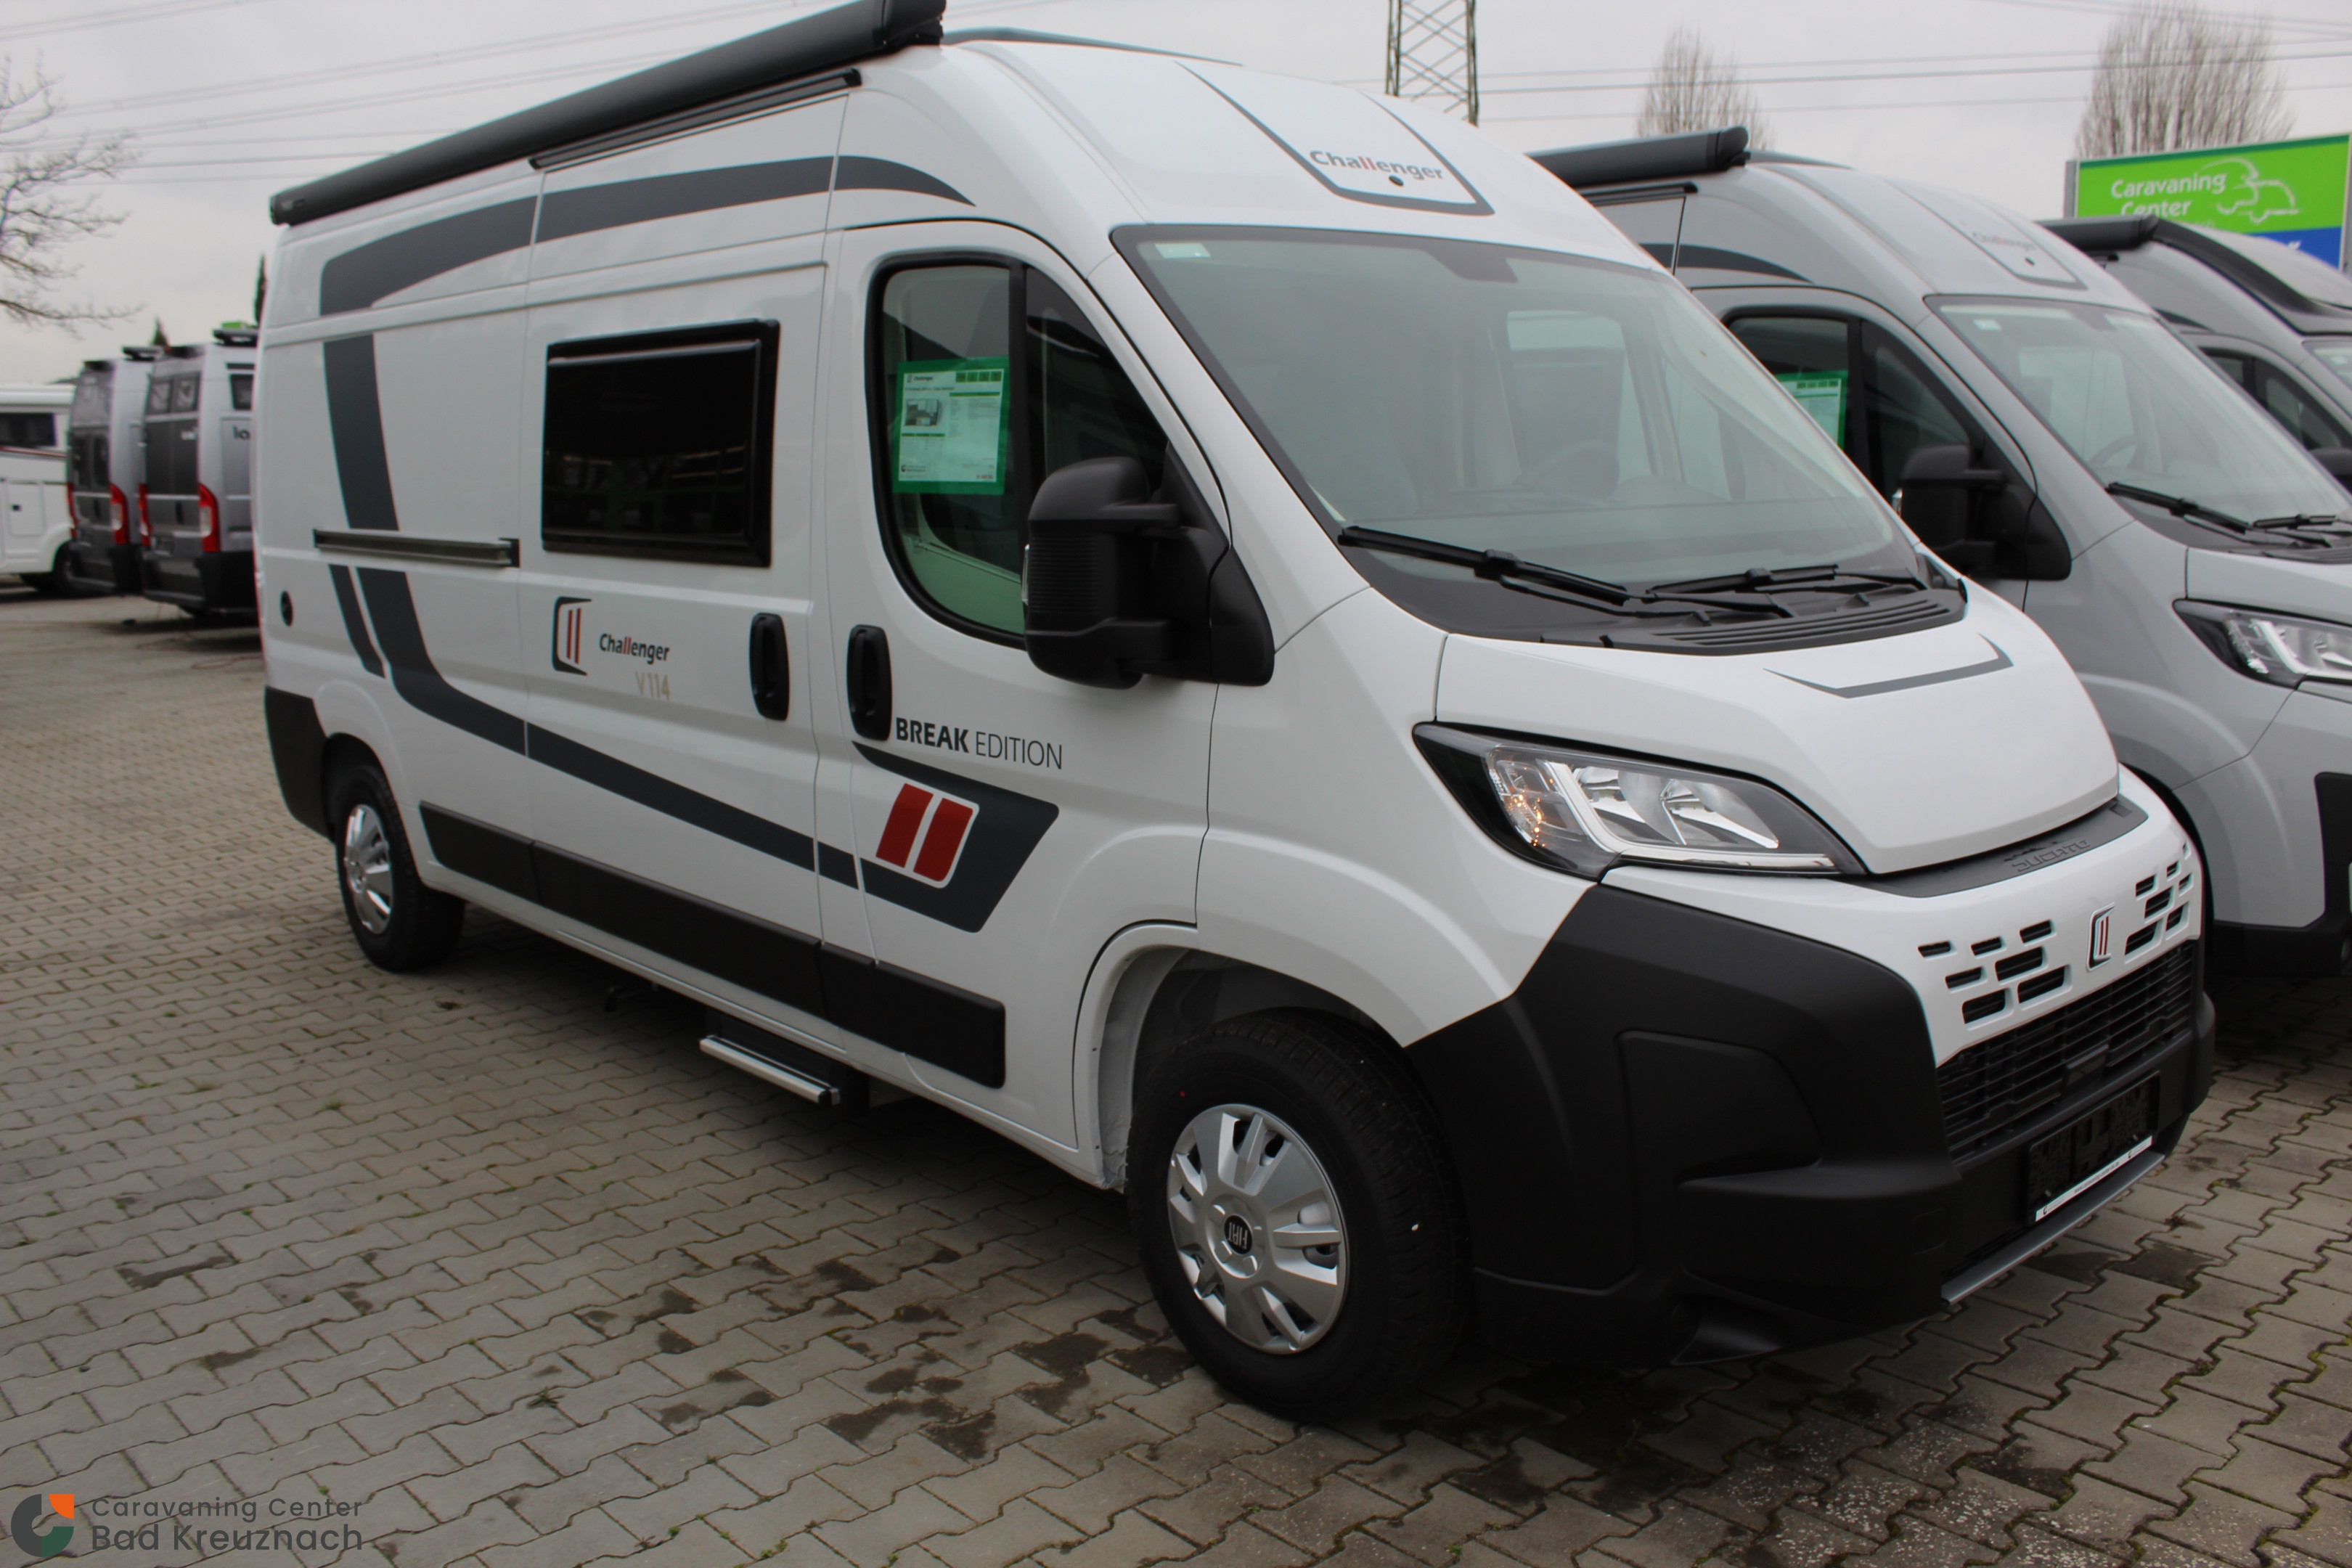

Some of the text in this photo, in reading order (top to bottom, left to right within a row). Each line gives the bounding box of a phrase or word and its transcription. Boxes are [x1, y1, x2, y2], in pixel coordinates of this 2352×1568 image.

[1310, 150, 1443, 180] Challenger
[2111, 172, 2228, 198] Caravaning
[599, 633, 670, 665] Challenger
[896, 717, 1062, 769] BREAK EDITION
[1227, 1222, 1249, 1249] FIAT
